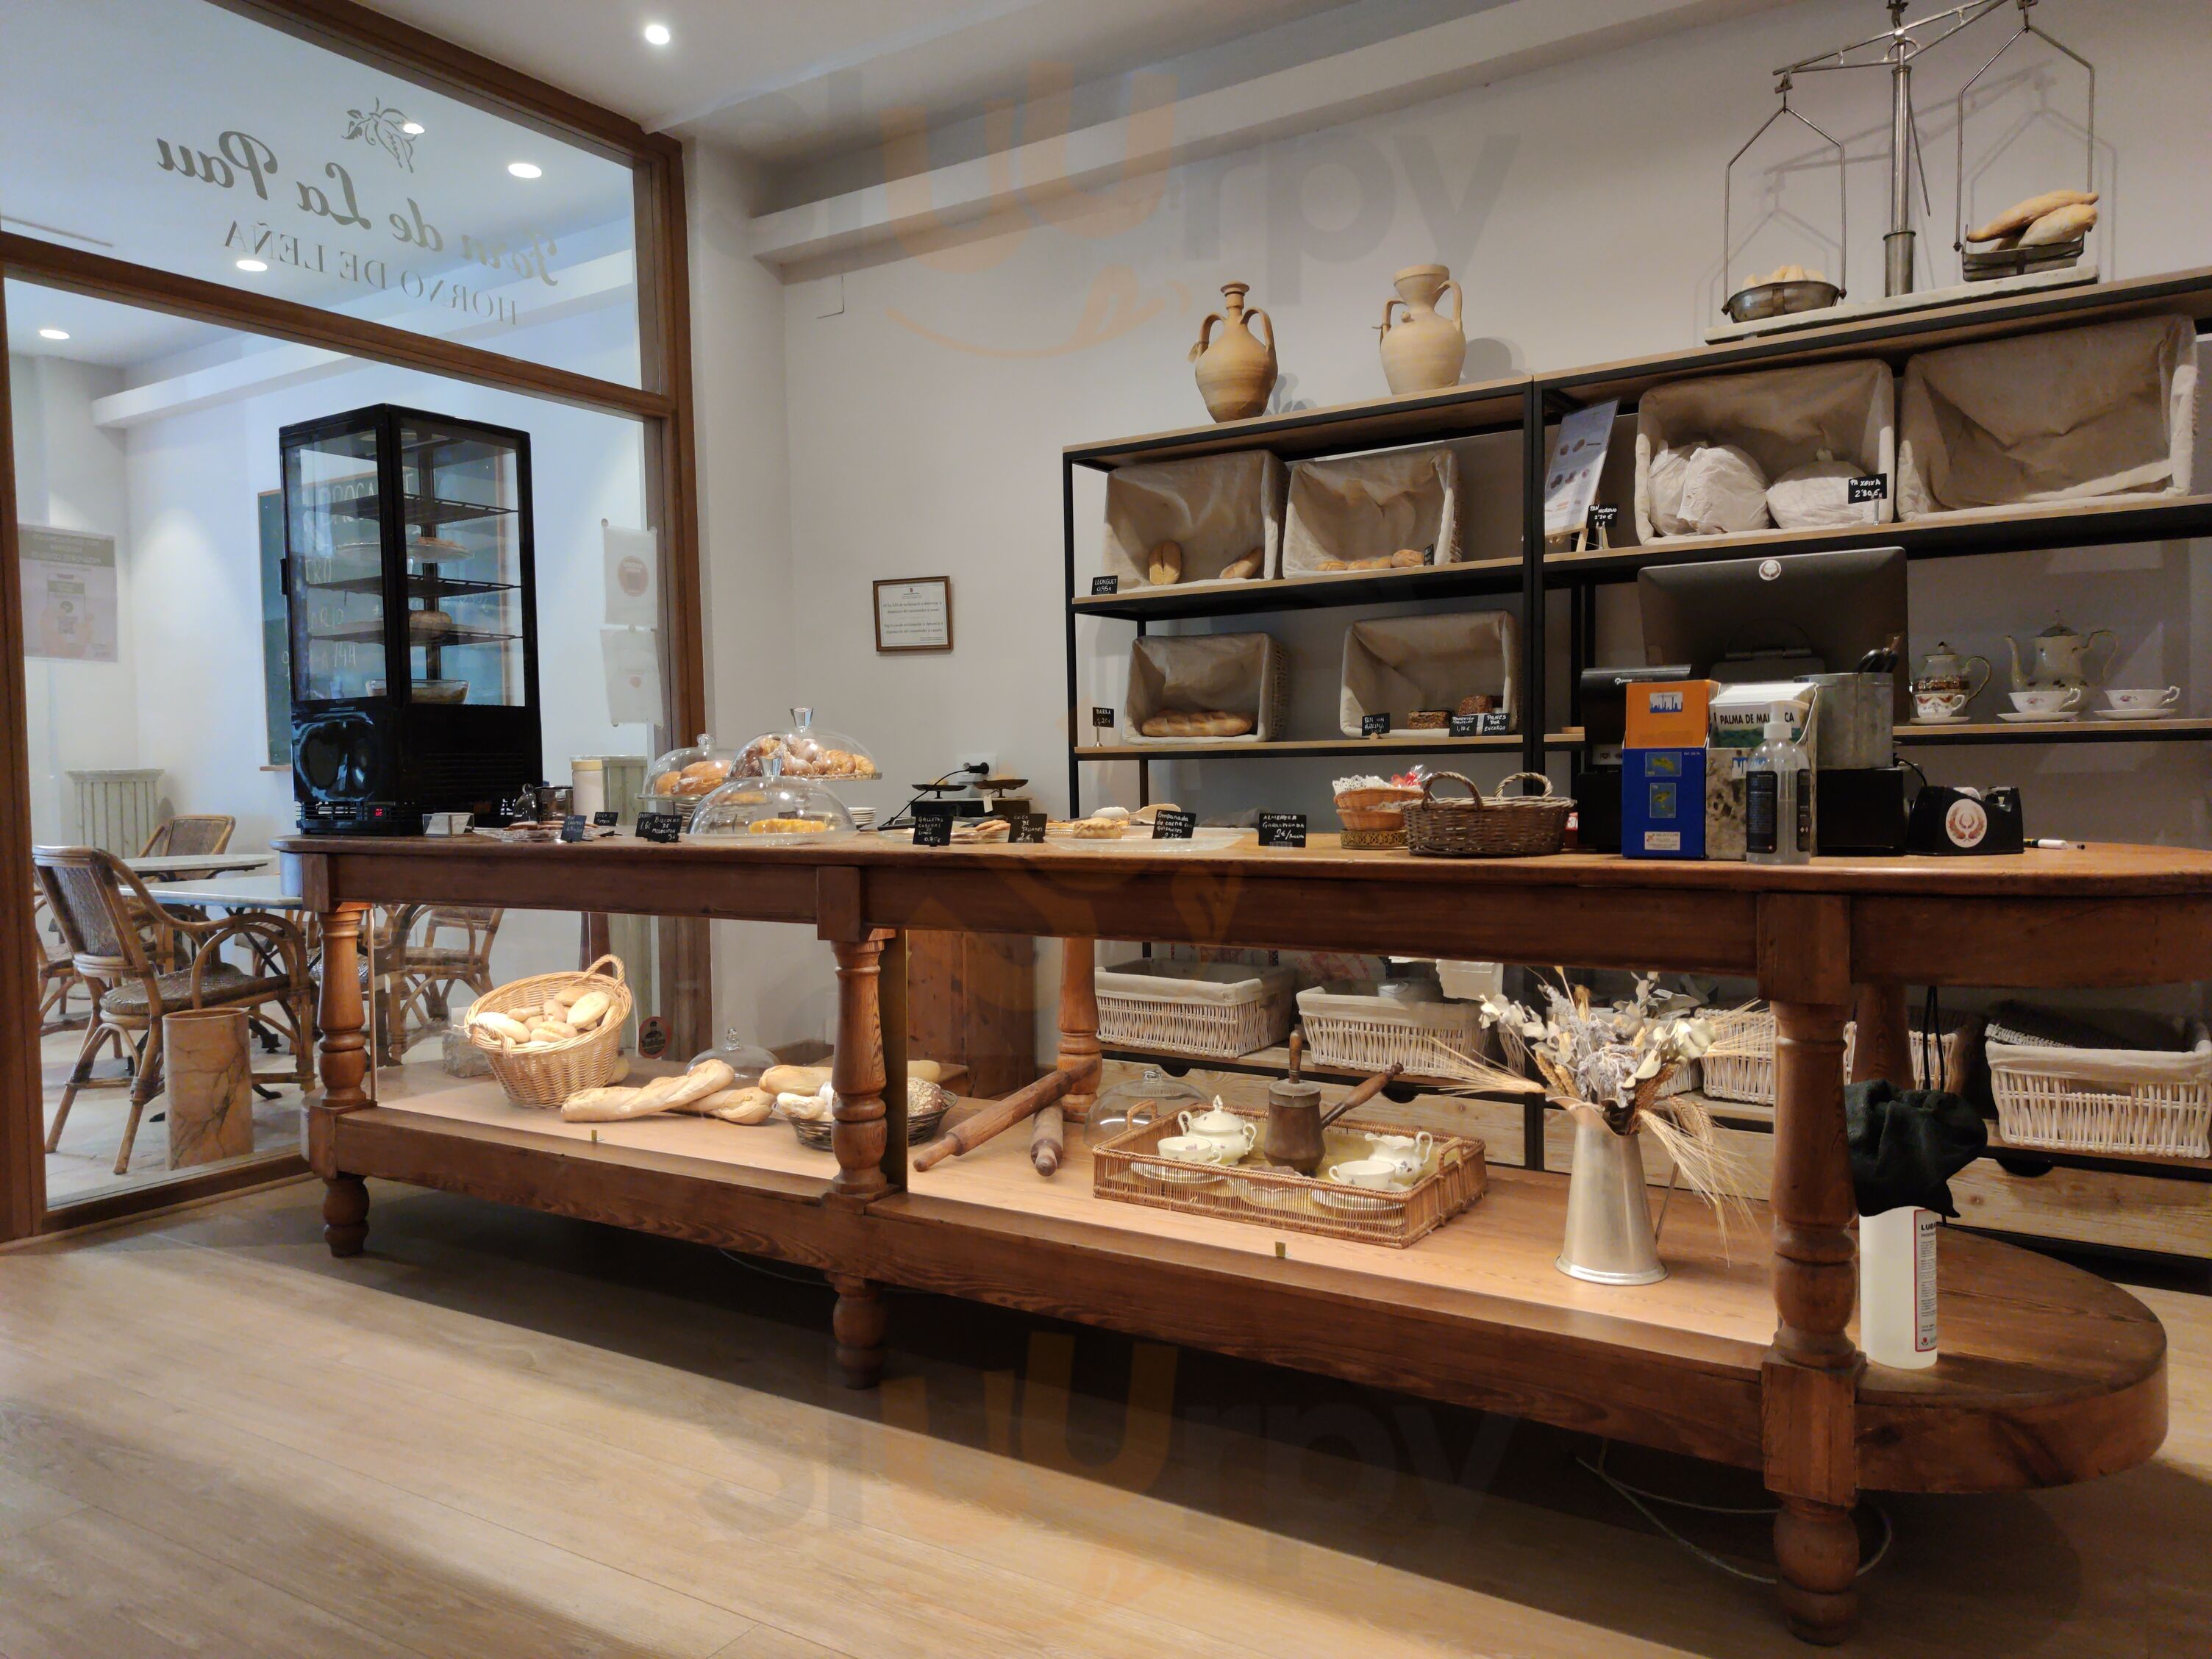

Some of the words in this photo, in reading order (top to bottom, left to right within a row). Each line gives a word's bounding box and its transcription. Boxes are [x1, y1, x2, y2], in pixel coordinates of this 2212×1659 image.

[1719, 714, 1744, 725] PALMA
[1745, 713, 1755, 724] DE
[1157, 810, 1189, 822] Empanada
